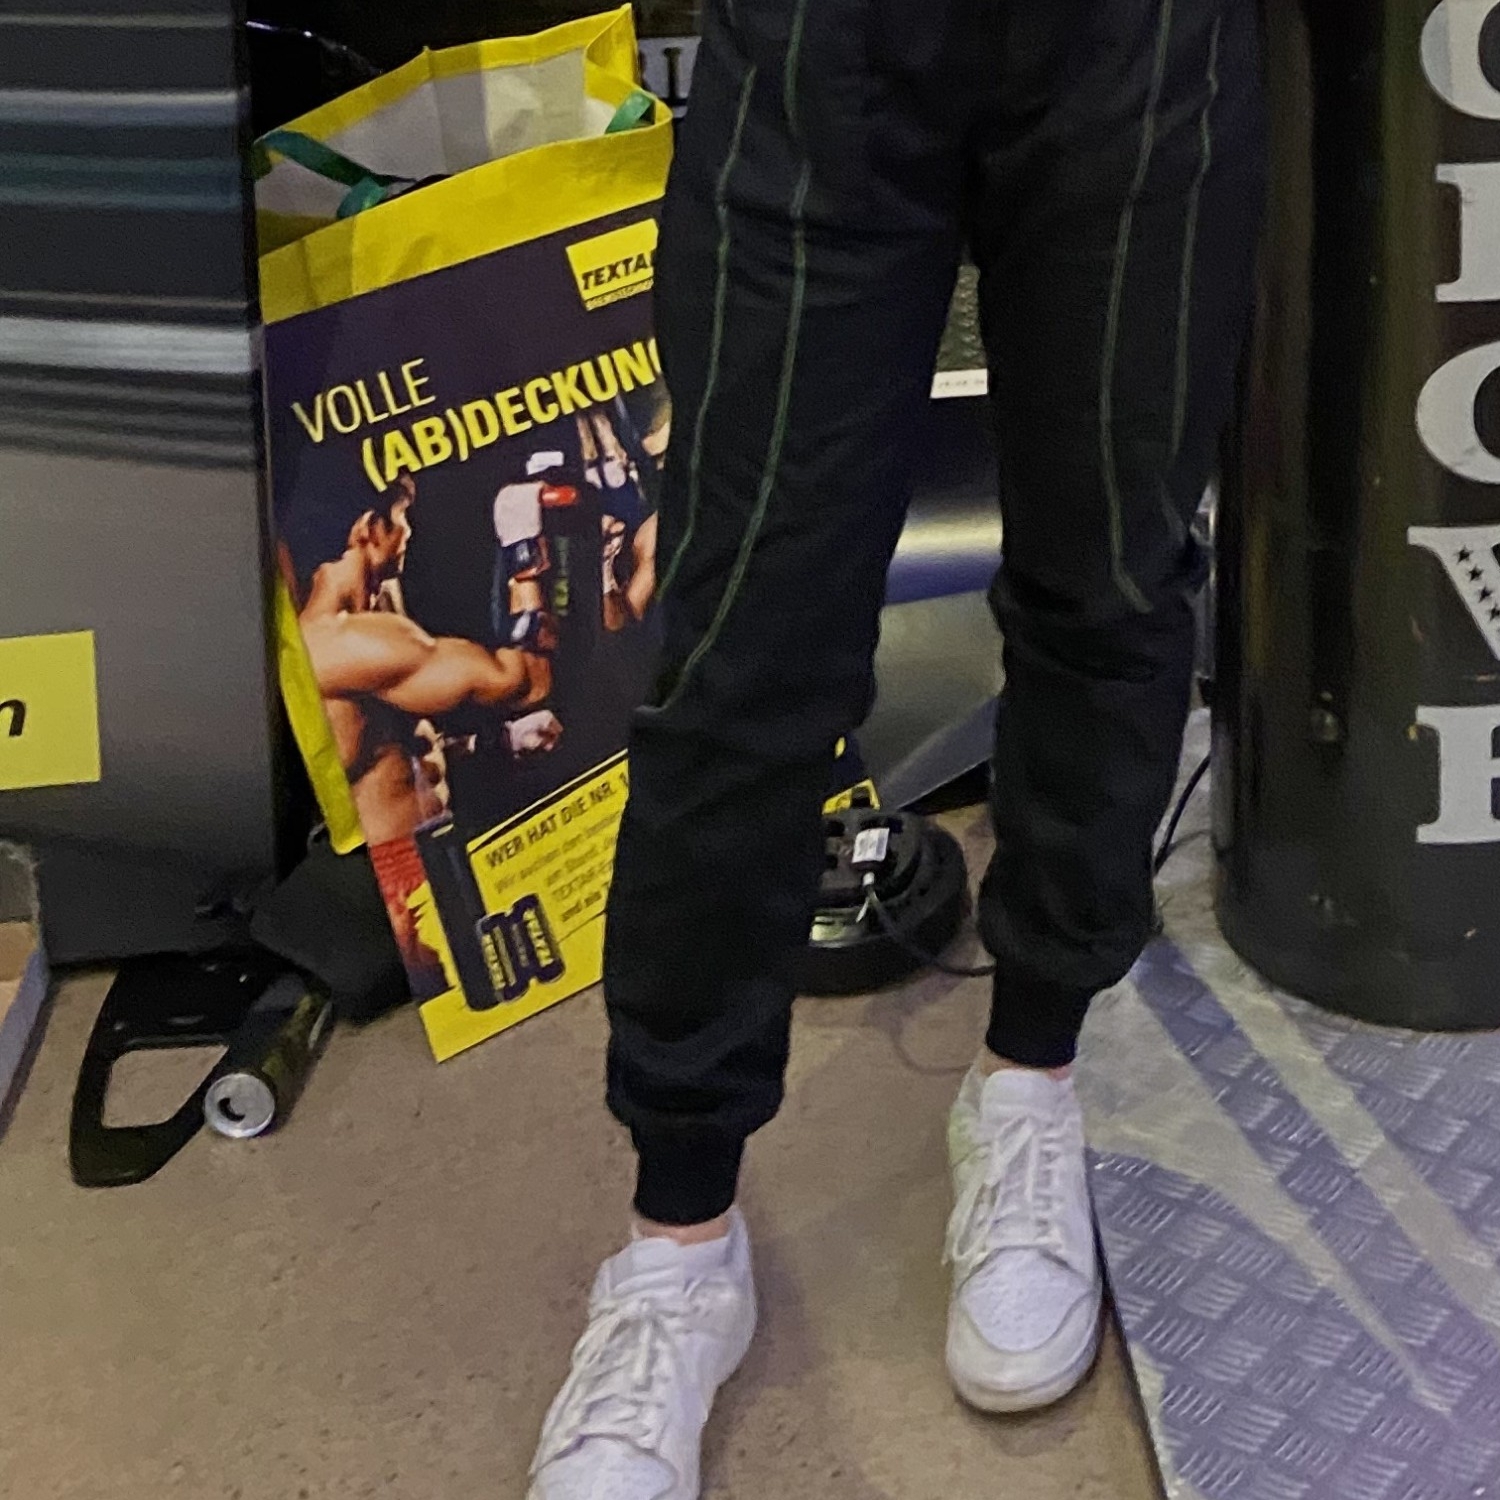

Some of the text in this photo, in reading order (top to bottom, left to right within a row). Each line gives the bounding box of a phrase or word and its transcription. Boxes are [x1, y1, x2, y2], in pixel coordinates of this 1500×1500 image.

[581, 251, 654, 291] TEXTA
[290, 357, 437, 444] VOLLE
[486, 835, 525, 869] WER
[526, 813, 557, 845] HAT
[561, 796, 588, 826] DIE
